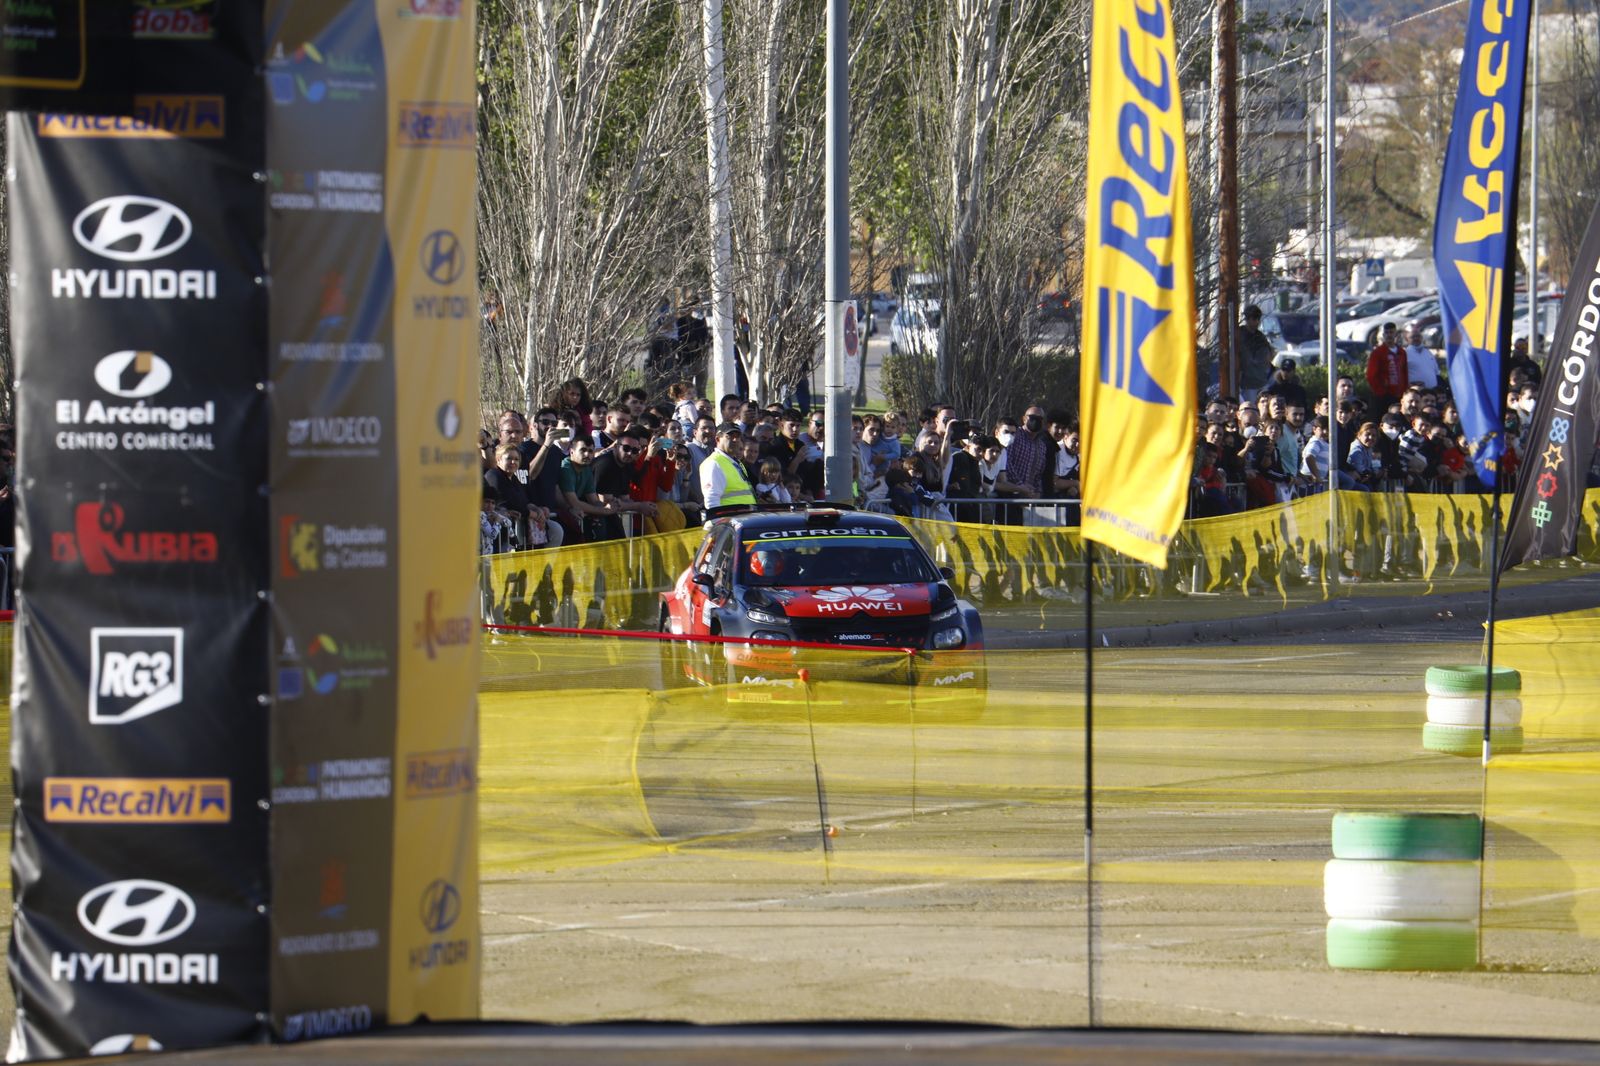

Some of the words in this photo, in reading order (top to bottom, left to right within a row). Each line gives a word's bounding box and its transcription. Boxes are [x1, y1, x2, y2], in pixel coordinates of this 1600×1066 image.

[52, 268, 217, 299] HYUNDAI
[1557, 257, 1600, 406] CÓRDO
[55, 400, 80, 424] El
[84, 400, 215, 430] Arcángel
[56, 431, 118, 450] CENTRO
[122, 432, 214, 450] COMERCIAL
[817, 602, 902, 612] HUAWEI
[100, 651, 172, 697] RG3
[934, 671, 975, 686] MMR
[77, 785, 196, 815] Recalvi
[51, 951, 218, 983] HYUNDAI
